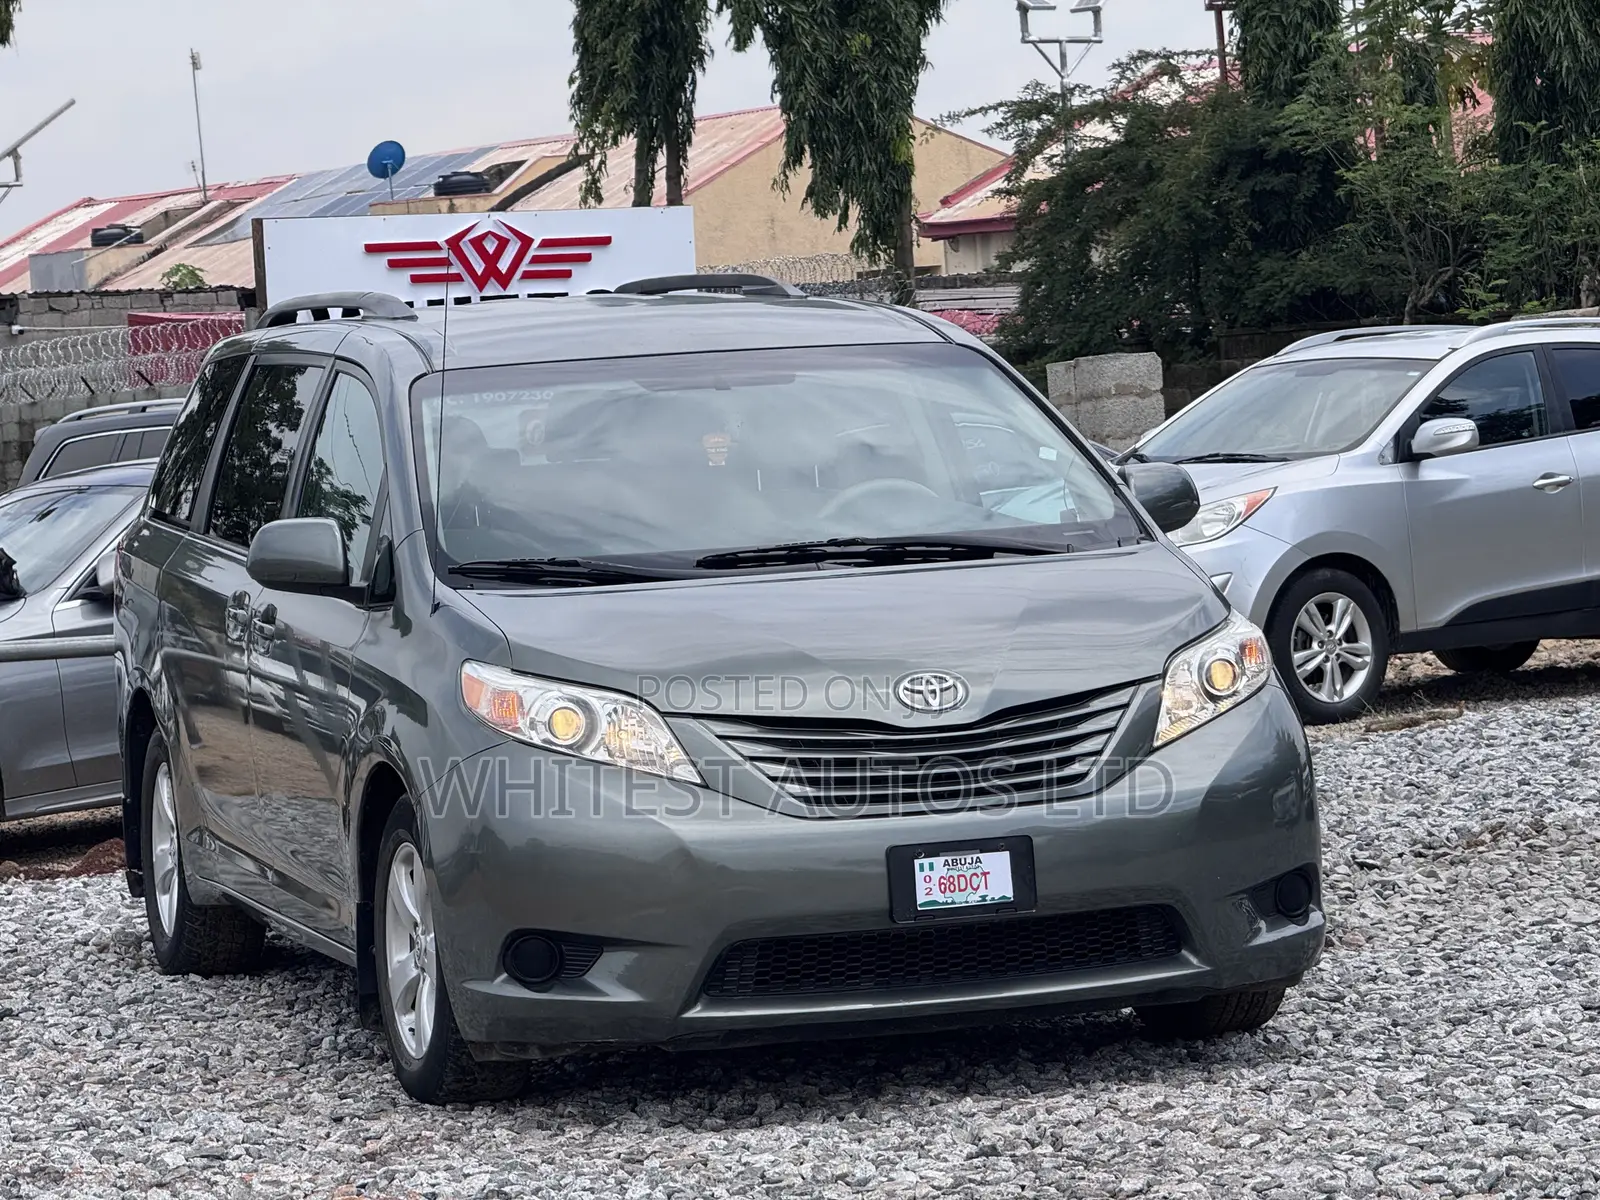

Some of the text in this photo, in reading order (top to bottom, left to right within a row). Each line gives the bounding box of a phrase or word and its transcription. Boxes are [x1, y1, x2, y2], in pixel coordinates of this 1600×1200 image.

[472, 389, 555, 407] 1907230
[942, 856, 983, 868] ABUJA
[938, 871, 991, 895] 68DCT
